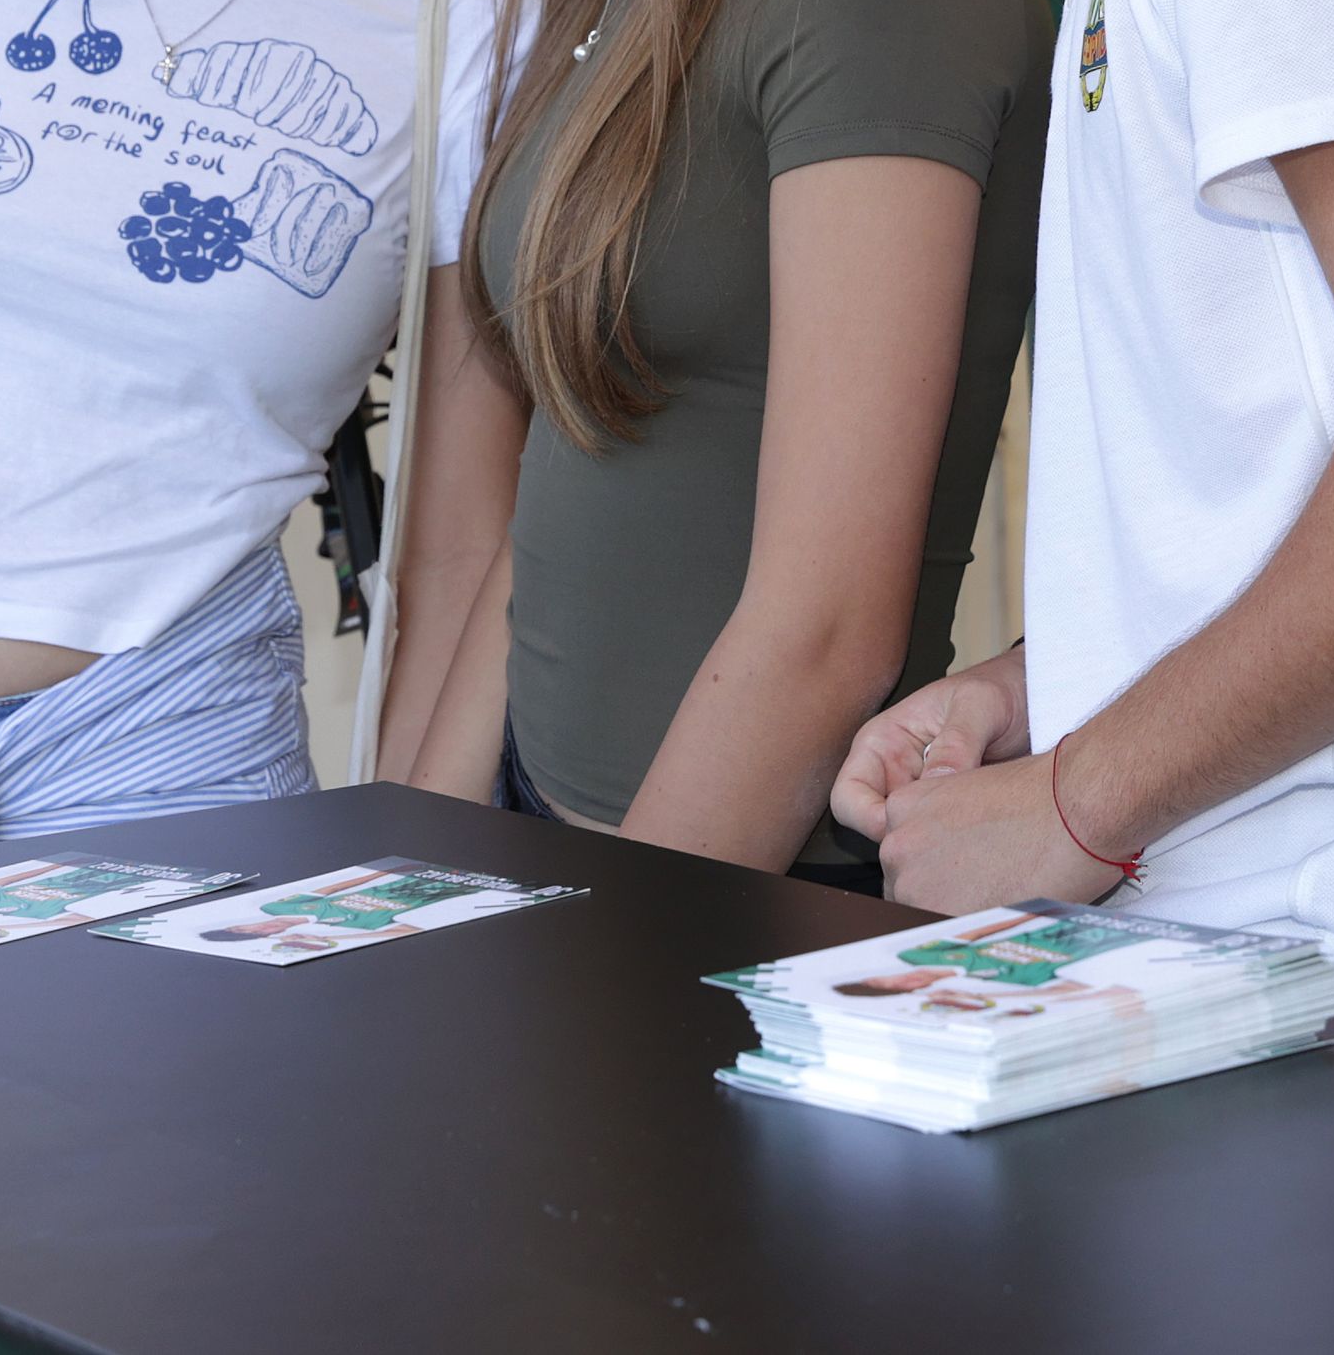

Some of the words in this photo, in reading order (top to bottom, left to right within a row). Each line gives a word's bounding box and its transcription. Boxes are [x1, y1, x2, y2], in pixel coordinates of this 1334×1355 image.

[32, 82, 57, 104] A
[181, 119, 258, 150] feast
[41, 120, 99, 143] for
[103, 131, 142, 158] the
[165, 149, 226, 175] soul
